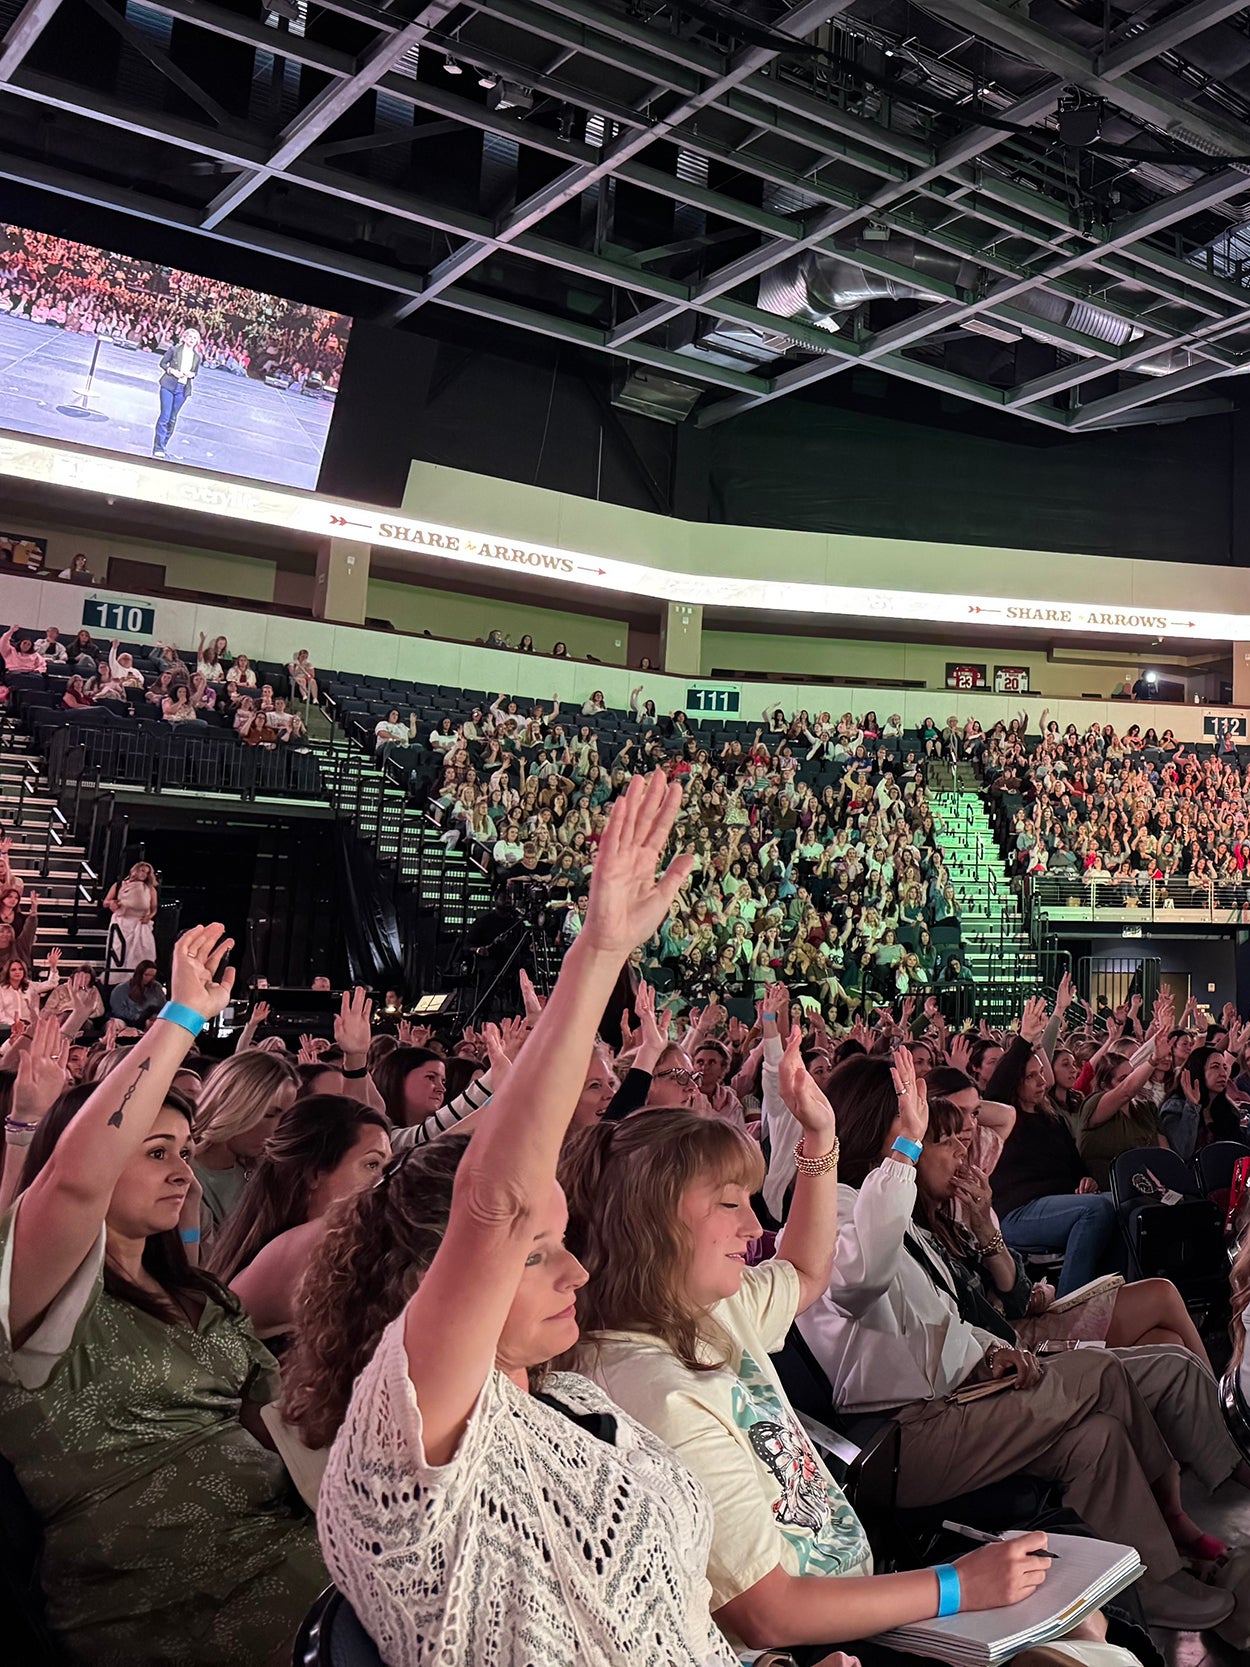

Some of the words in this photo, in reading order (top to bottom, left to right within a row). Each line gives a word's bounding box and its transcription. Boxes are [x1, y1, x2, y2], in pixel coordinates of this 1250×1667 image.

[378, 522, 460, 551] SHARE
[477, 543, 574, 572] ARROWS
[96, 603, 143, 632] 110
[1006, 606, 1072, 622] SHARE
[1087, 612, 1167, 629] ARROWS
[959, 675, 973, 689] 23
[1004, 677, 1019, 690] 20
[696, 690, 729, 711] 111
[1211, 717, 1240, 736] 112
